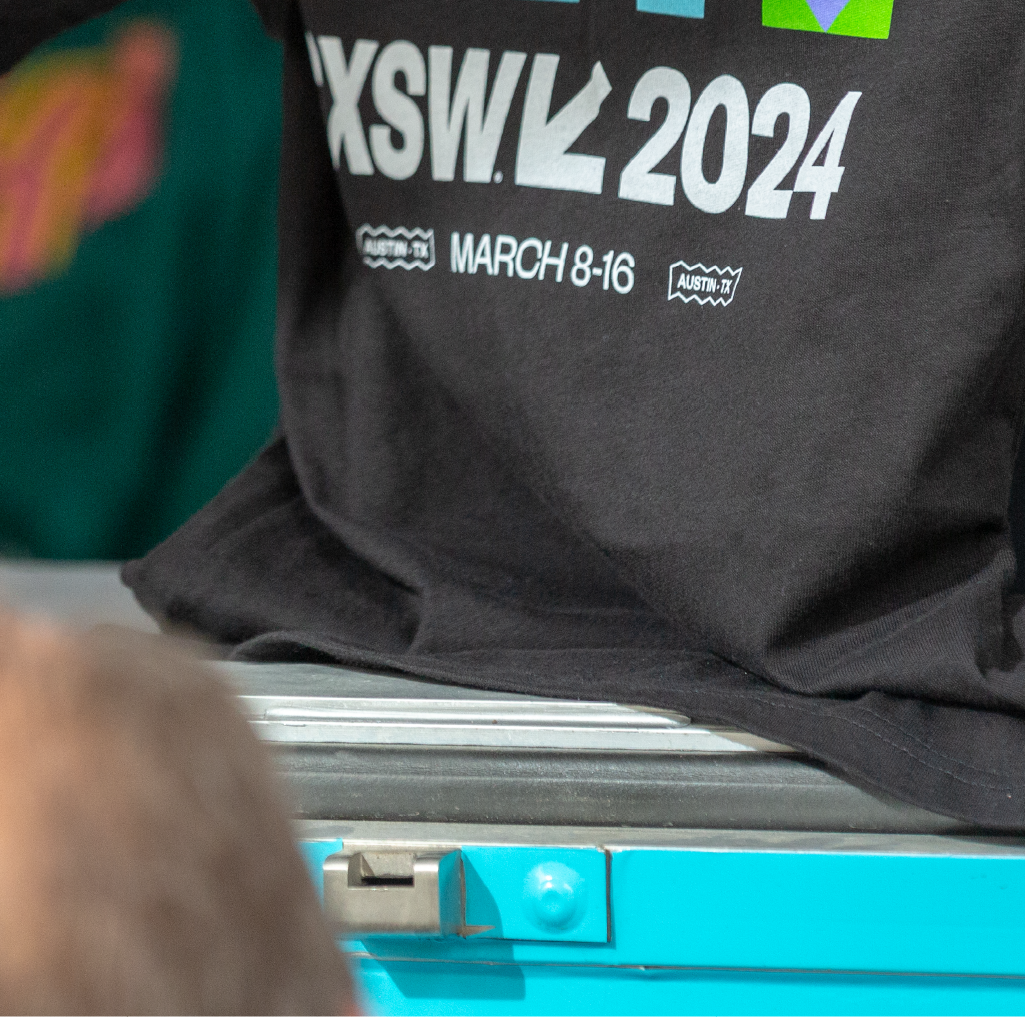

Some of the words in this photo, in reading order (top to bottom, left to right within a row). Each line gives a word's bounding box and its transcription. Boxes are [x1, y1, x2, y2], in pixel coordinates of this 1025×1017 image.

[618, 66, 863, 221] 2024
[450, 231, 569, 284] MARCH
[570, 244, 636, 295] 8-16
